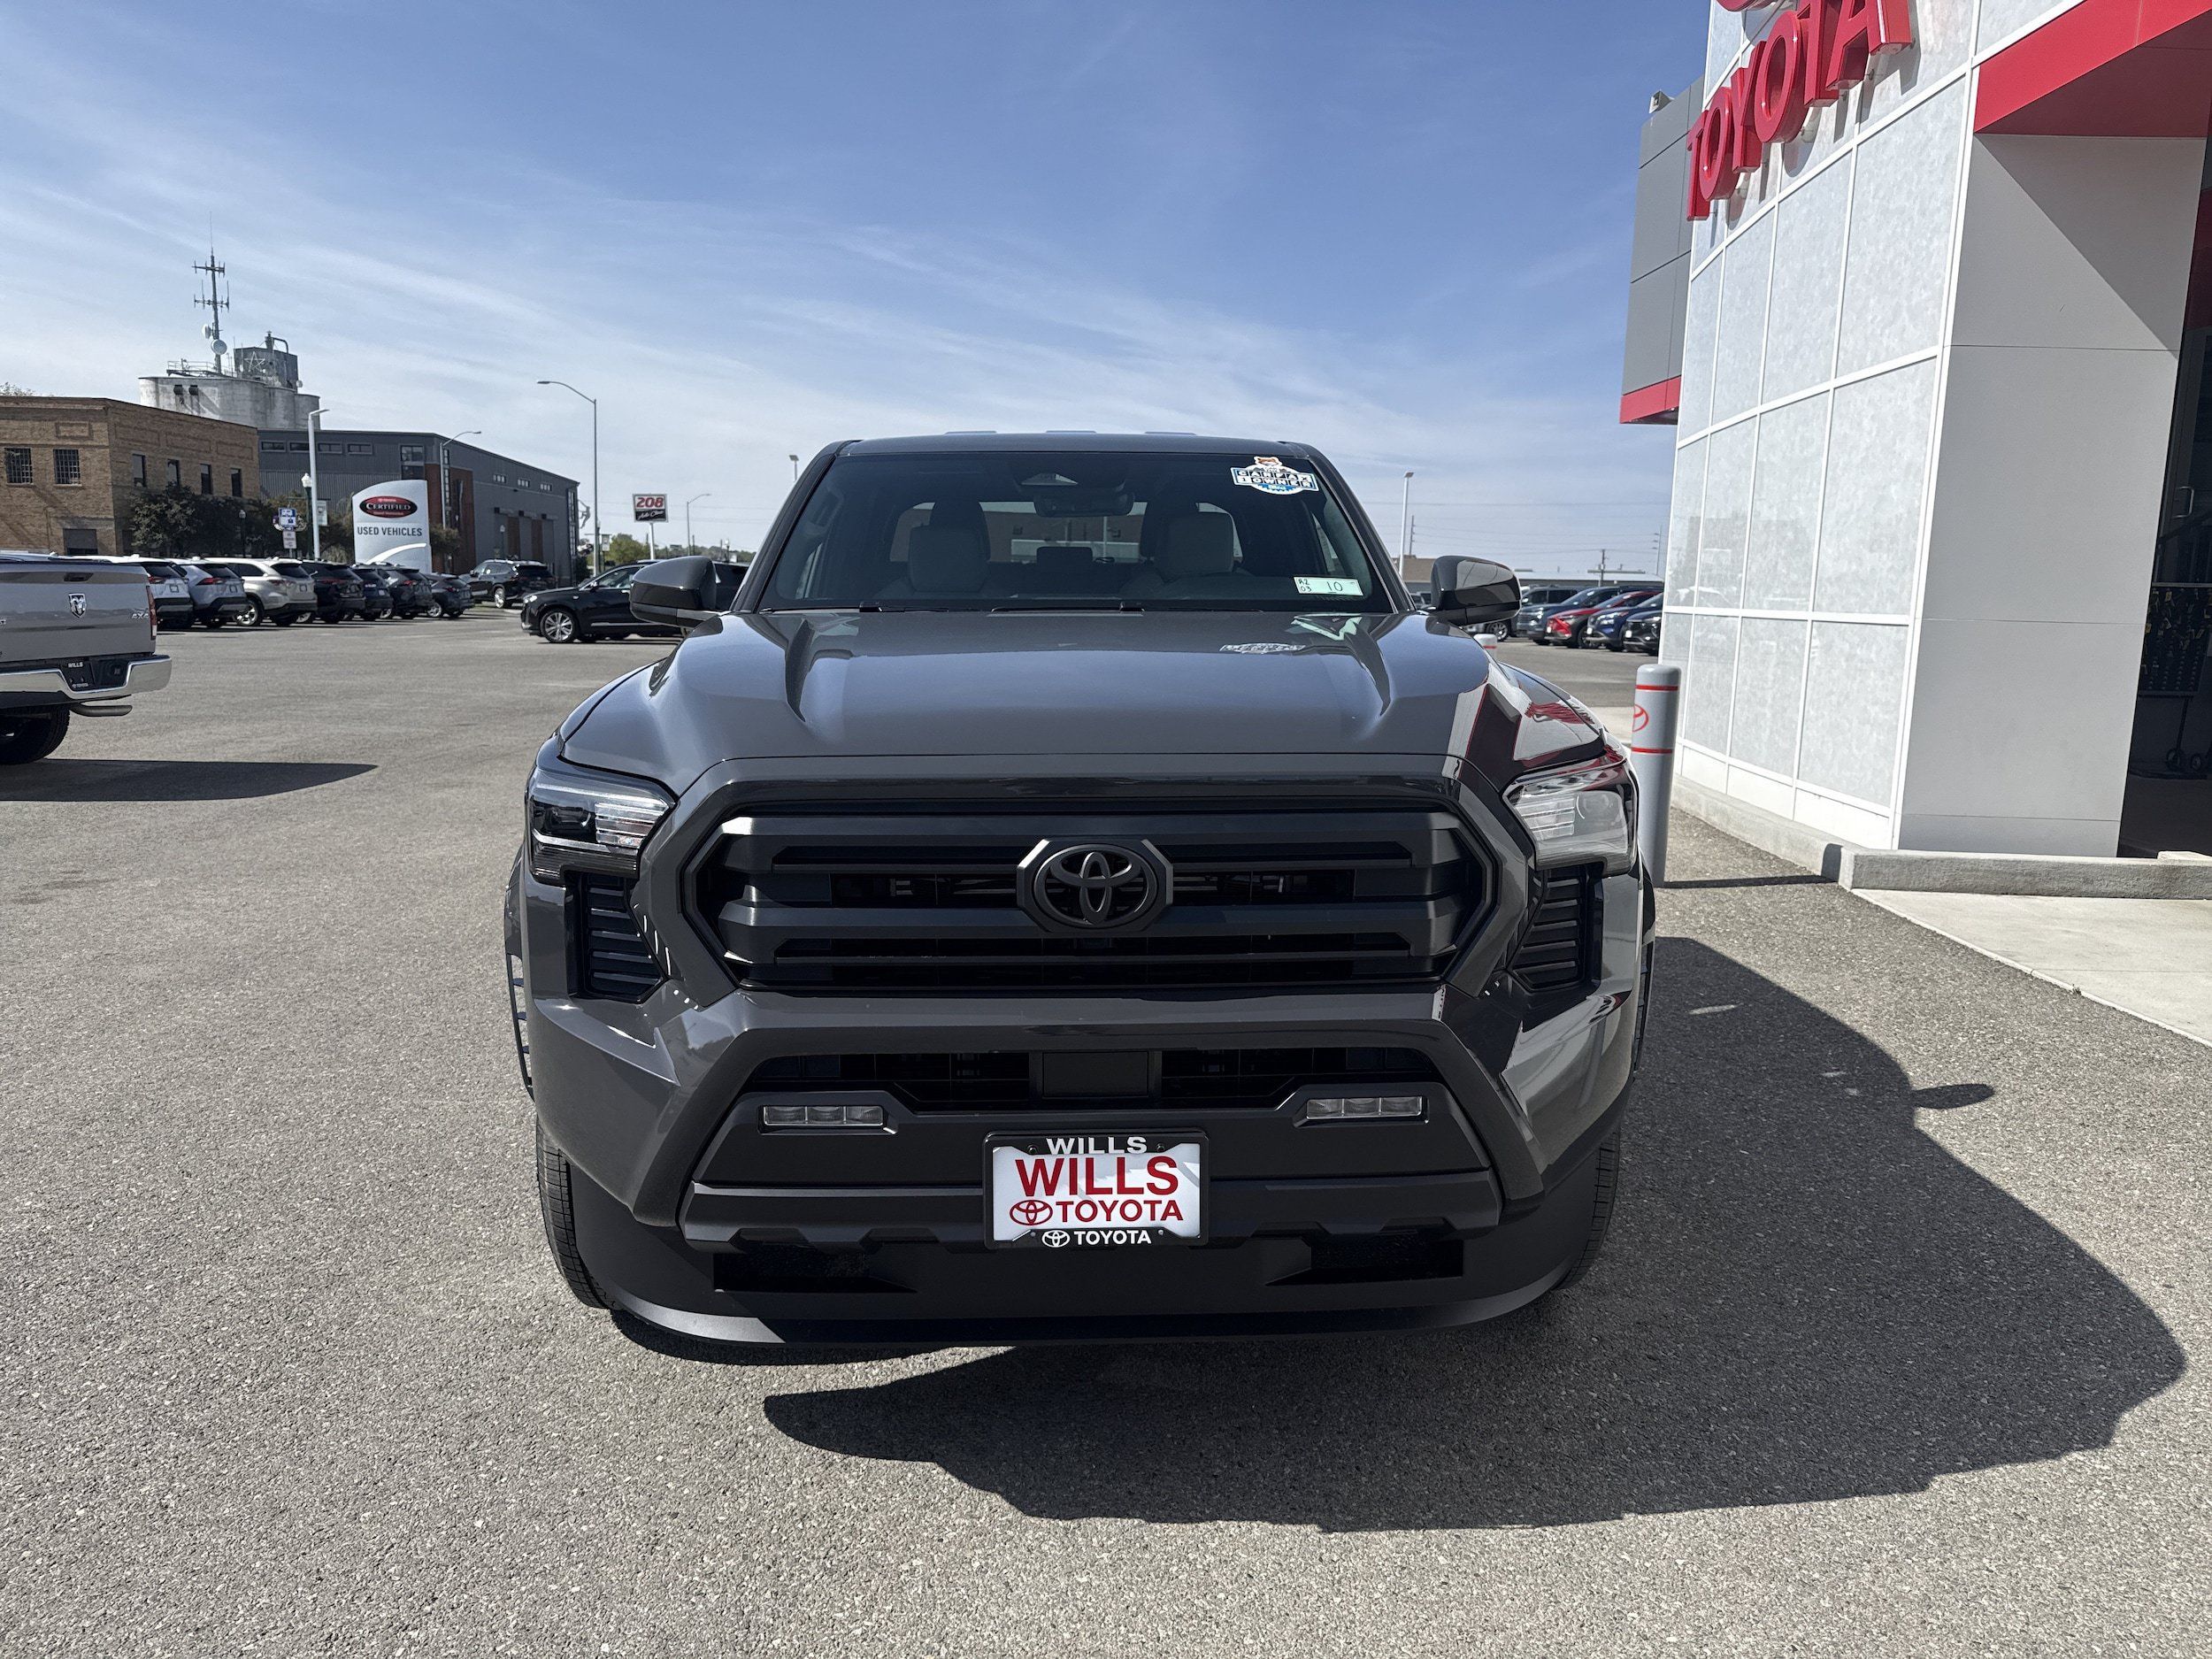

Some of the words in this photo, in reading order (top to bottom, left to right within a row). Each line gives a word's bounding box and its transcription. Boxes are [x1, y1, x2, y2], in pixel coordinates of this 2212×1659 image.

[1686, 0, 1912, 220] TOYOTA
[1239, 471, 1311, 482] CARFAX
[1252, 478, 1311, 488] OWNER
[636, 497, 664, 508] 208
[357, 526, 379, 535] USED
[381, 527, 422, 536] VEHICLES
[1046, 1136, 1148, 1156] WILLS
[1015, 1156, 1179, 1197] WILLS
[1056, 1199, 1184, 1223] TOYOTA
[1073, 1230, 1152, 1246] TOYOTA
